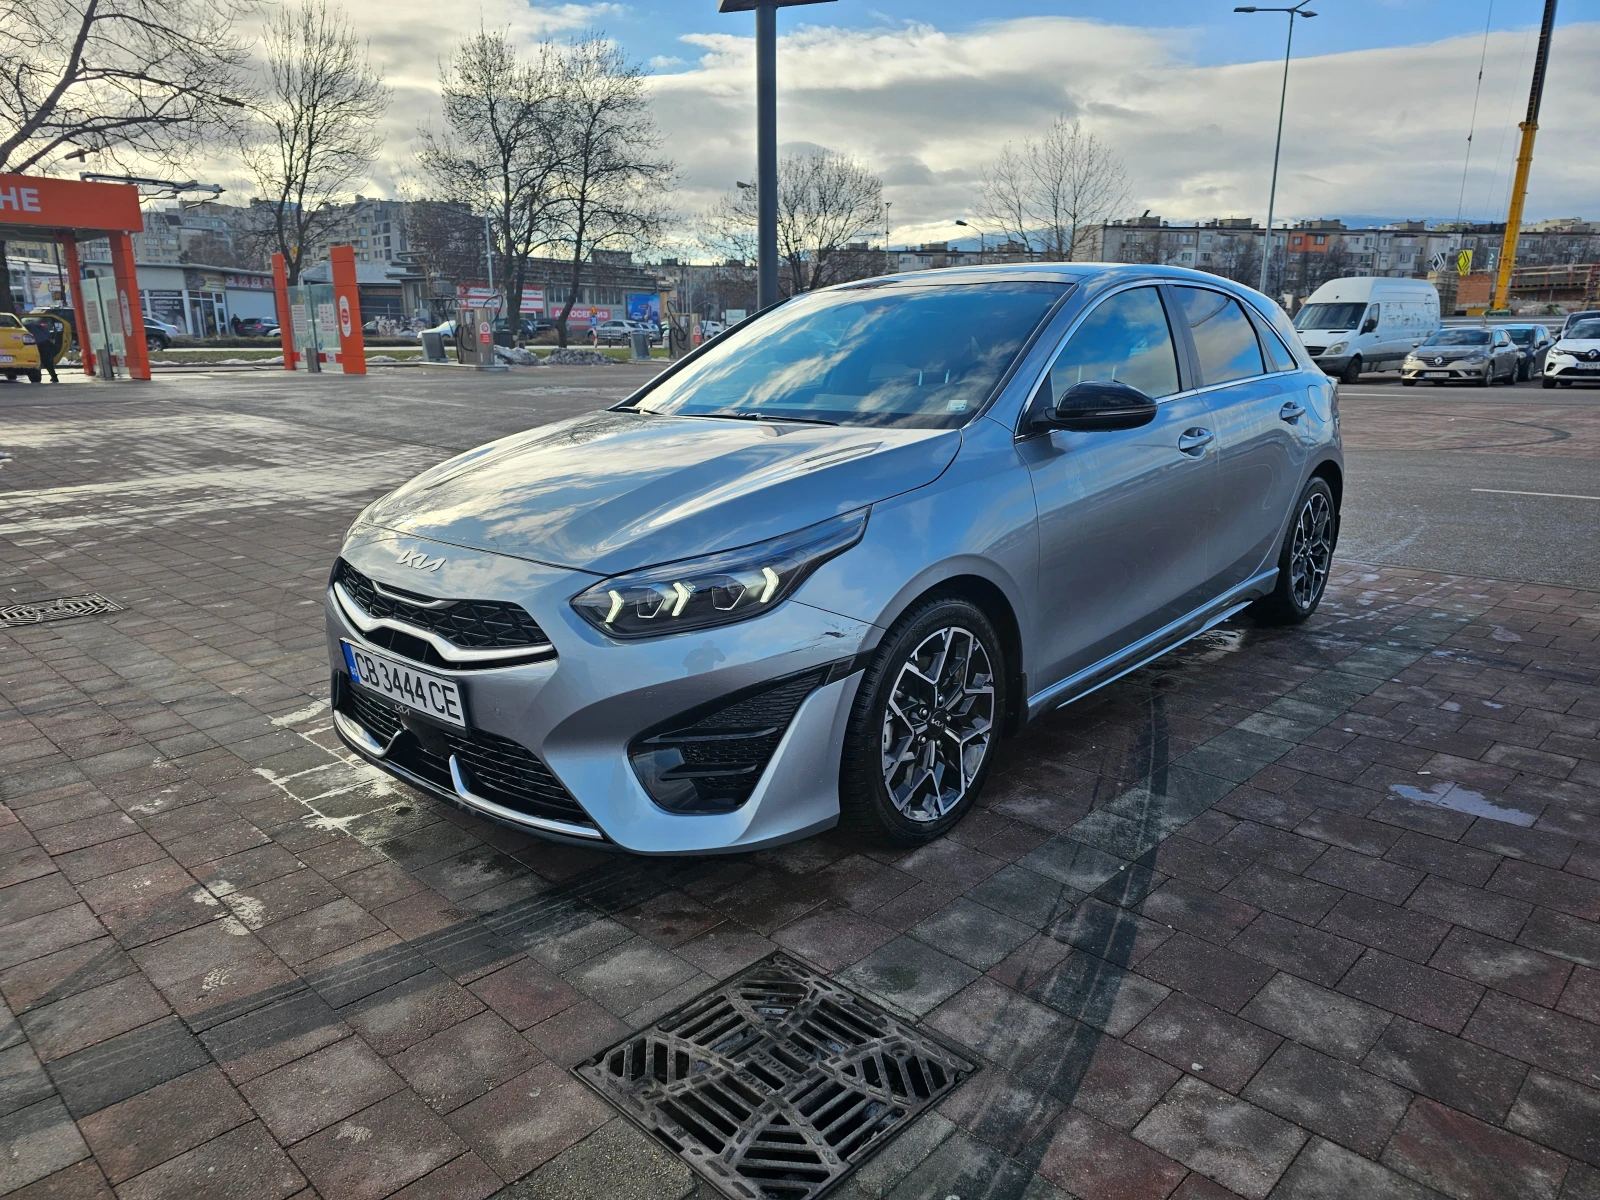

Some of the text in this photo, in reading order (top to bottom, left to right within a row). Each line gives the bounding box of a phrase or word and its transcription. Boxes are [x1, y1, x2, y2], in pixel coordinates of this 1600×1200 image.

[395, 550, 447, 573] KIA
[354, 652, 461, 720] CB 3444 CE
